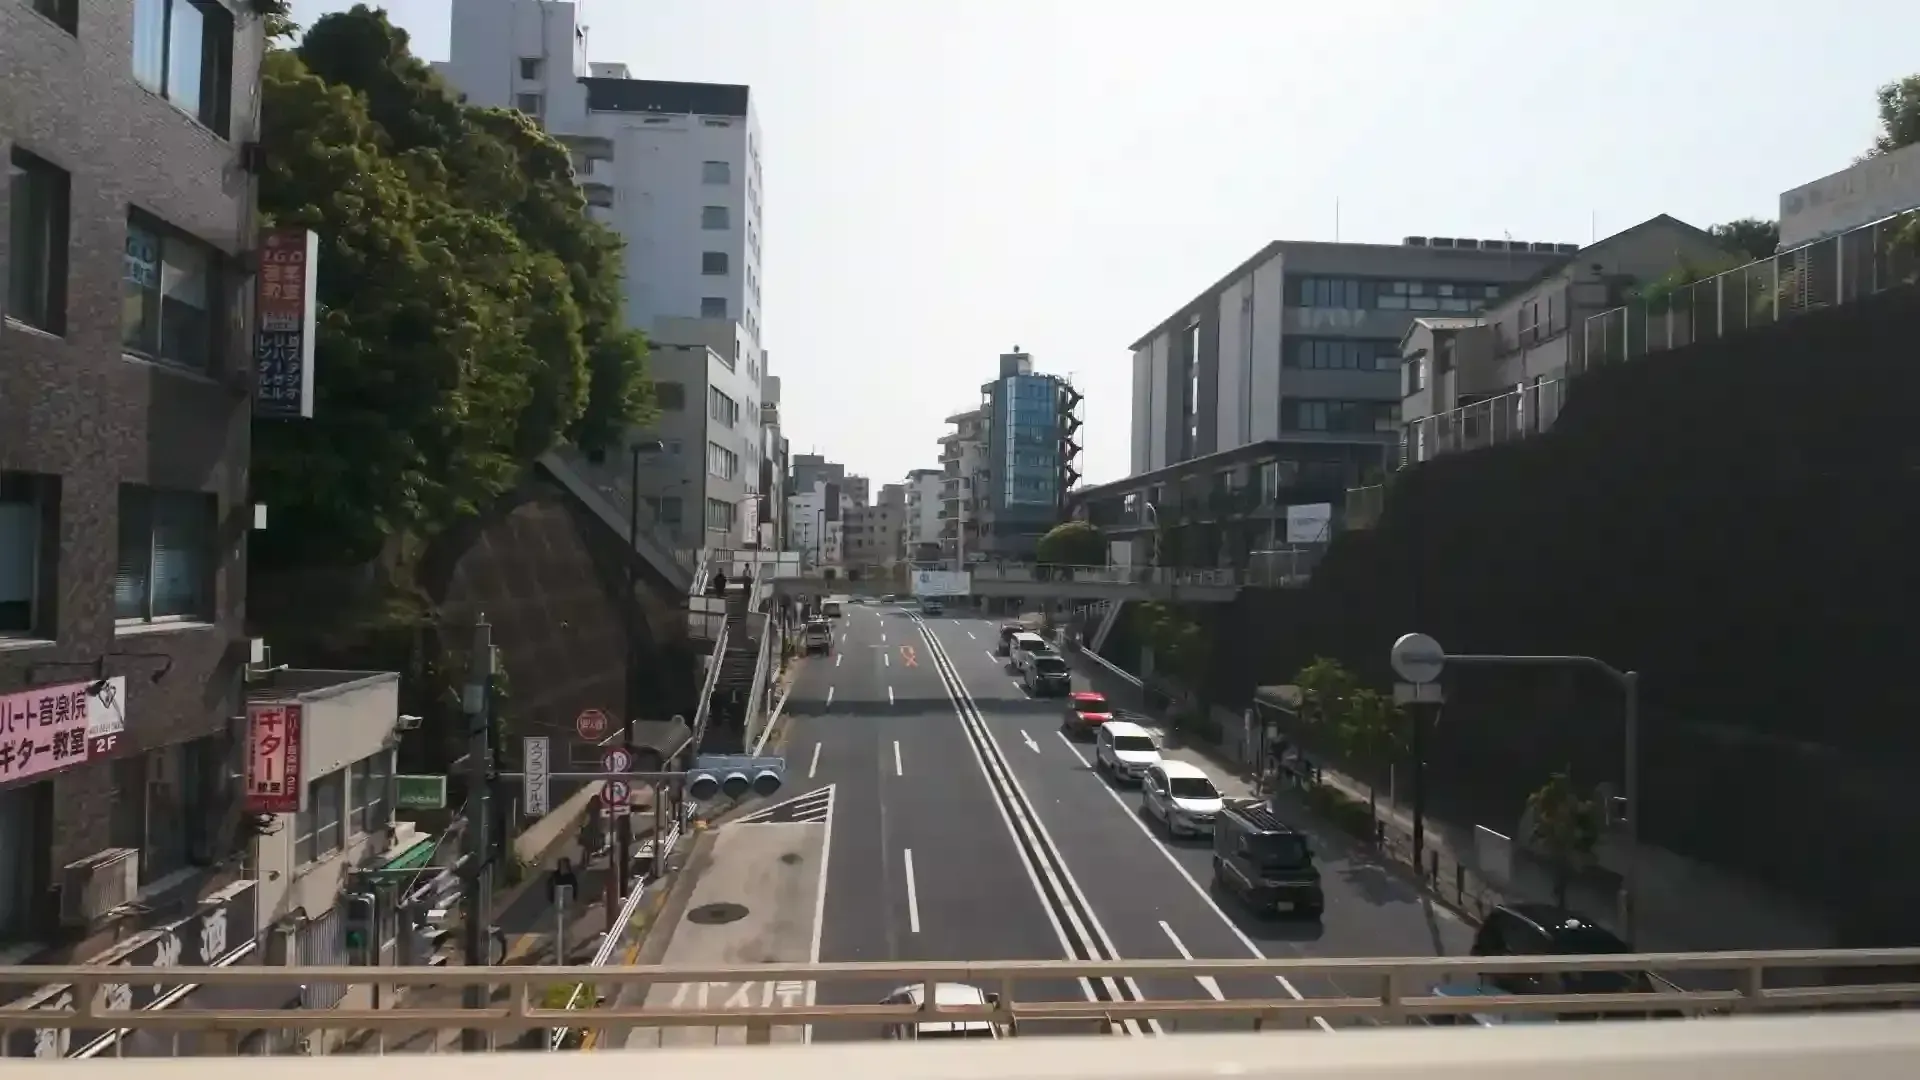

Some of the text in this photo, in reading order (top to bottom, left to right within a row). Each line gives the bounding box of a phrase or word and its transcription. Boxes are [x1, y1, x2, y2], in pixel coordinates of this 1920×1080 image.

[0, 726, 86, 774] ギター教室
[96, 735, 117, 753] 2F
